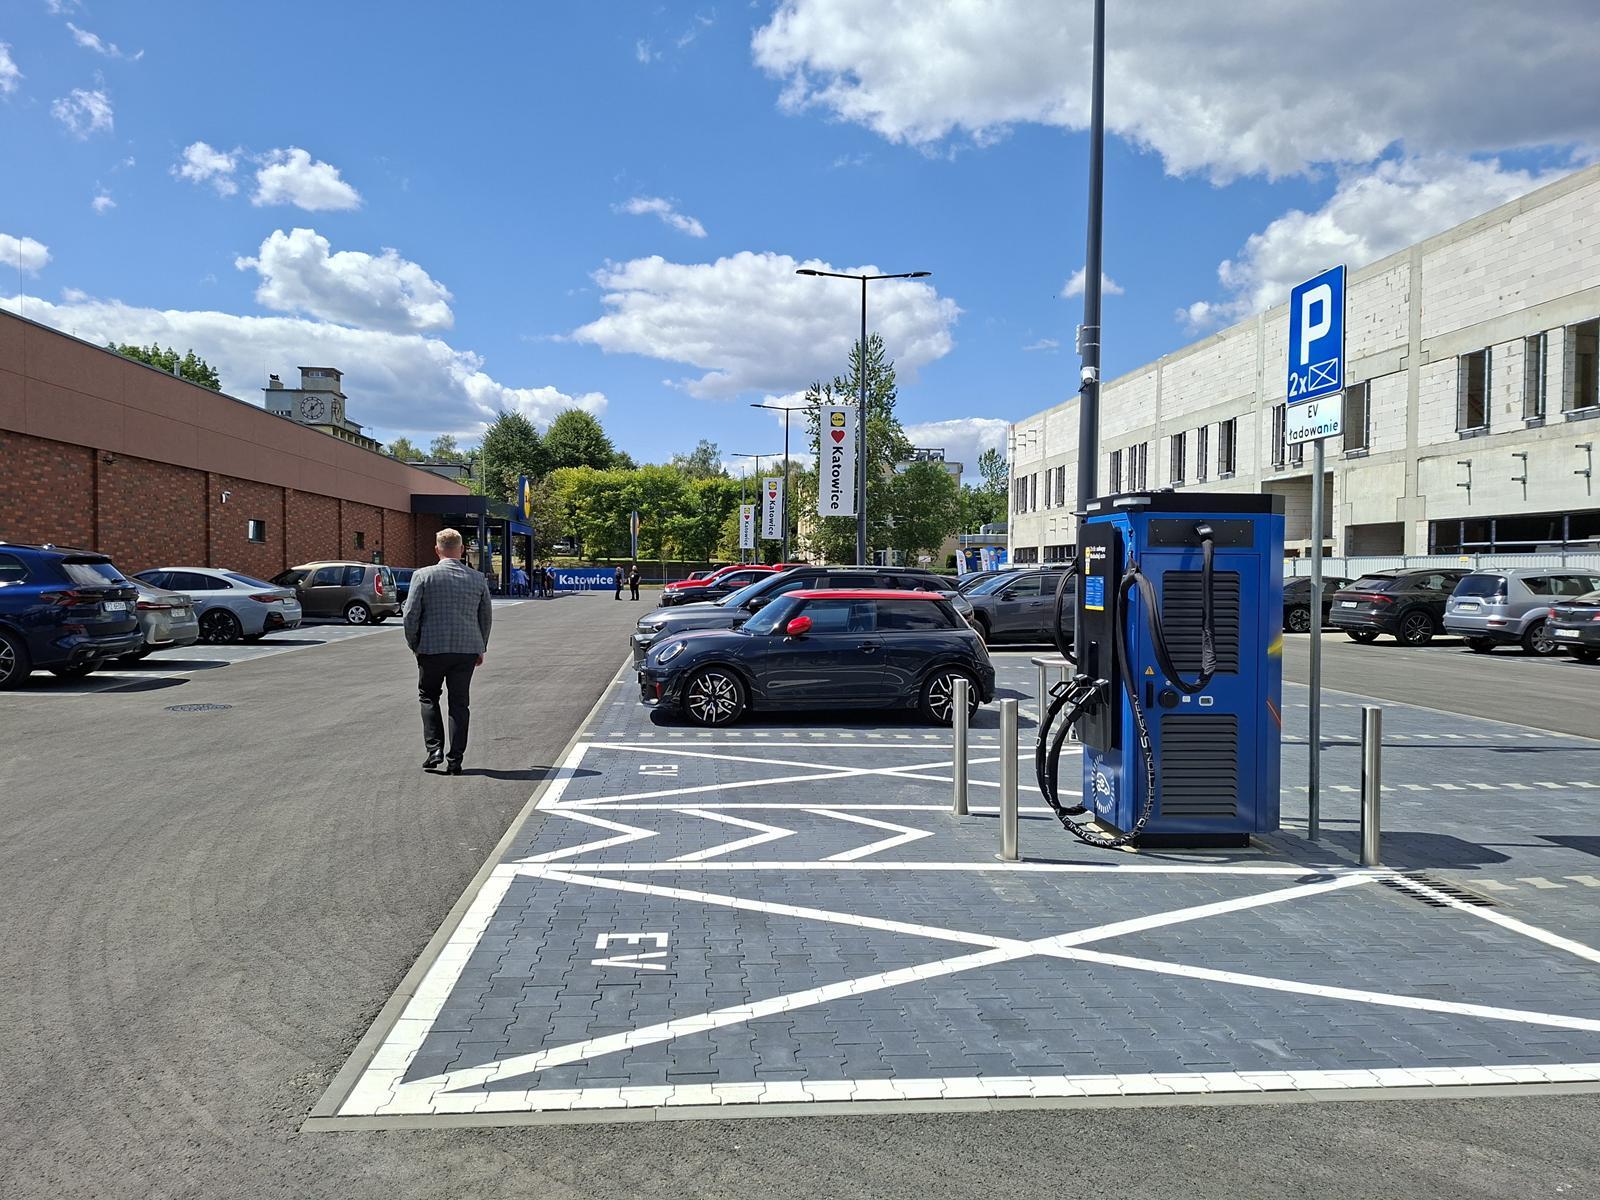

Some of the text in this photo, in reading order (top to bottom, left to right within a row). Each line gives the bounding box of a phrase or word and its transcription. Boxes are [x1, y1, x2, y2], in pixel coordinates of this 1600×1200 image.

[1300, 283, 1332, 365] P
[1289, 372, 1307, 397] 2x
[1308, 404, 1318, 418] EV
[1289, 419, 1338, 440] ładowanie
[831, 446, 844, 510] Katowice
[559, 575, 614, 585] Katowice
[639, 765, 678, 777] EV
[590, 932, 669, 971] EV
